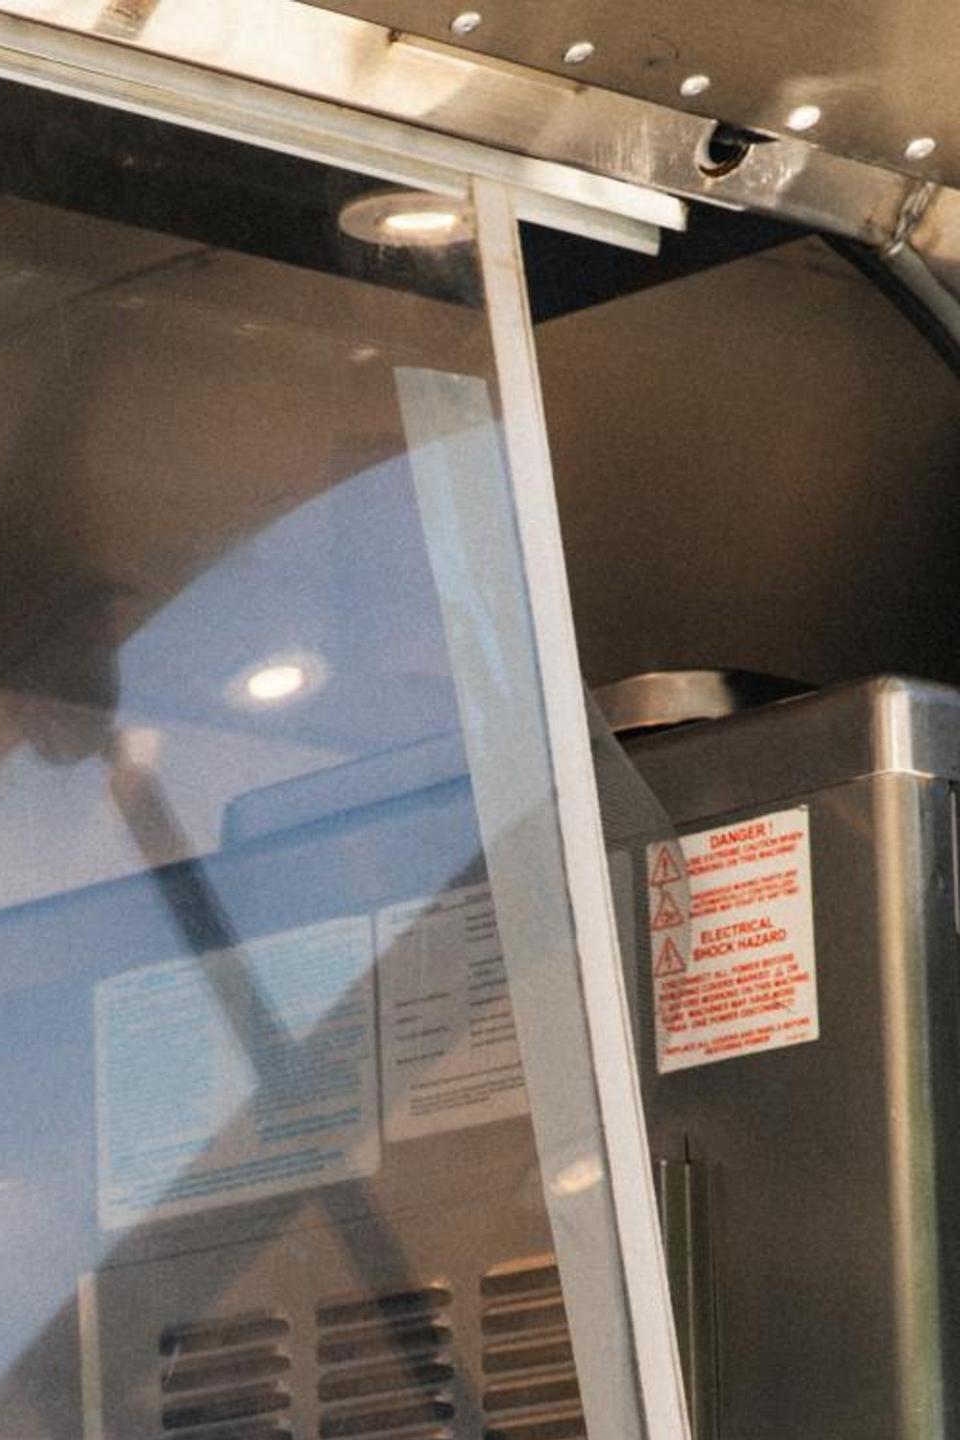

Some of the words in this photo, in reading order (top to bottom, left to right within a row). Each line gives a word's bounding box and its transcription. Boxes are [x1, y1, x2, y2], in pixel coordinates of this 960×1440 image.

[710, 823, 765, 848] DANGER
[700, 917, 773, 944] ELECTRICAL
[693, 943, 734, 962] SHOCK
[737, 929, 787, 949] HAZARD
